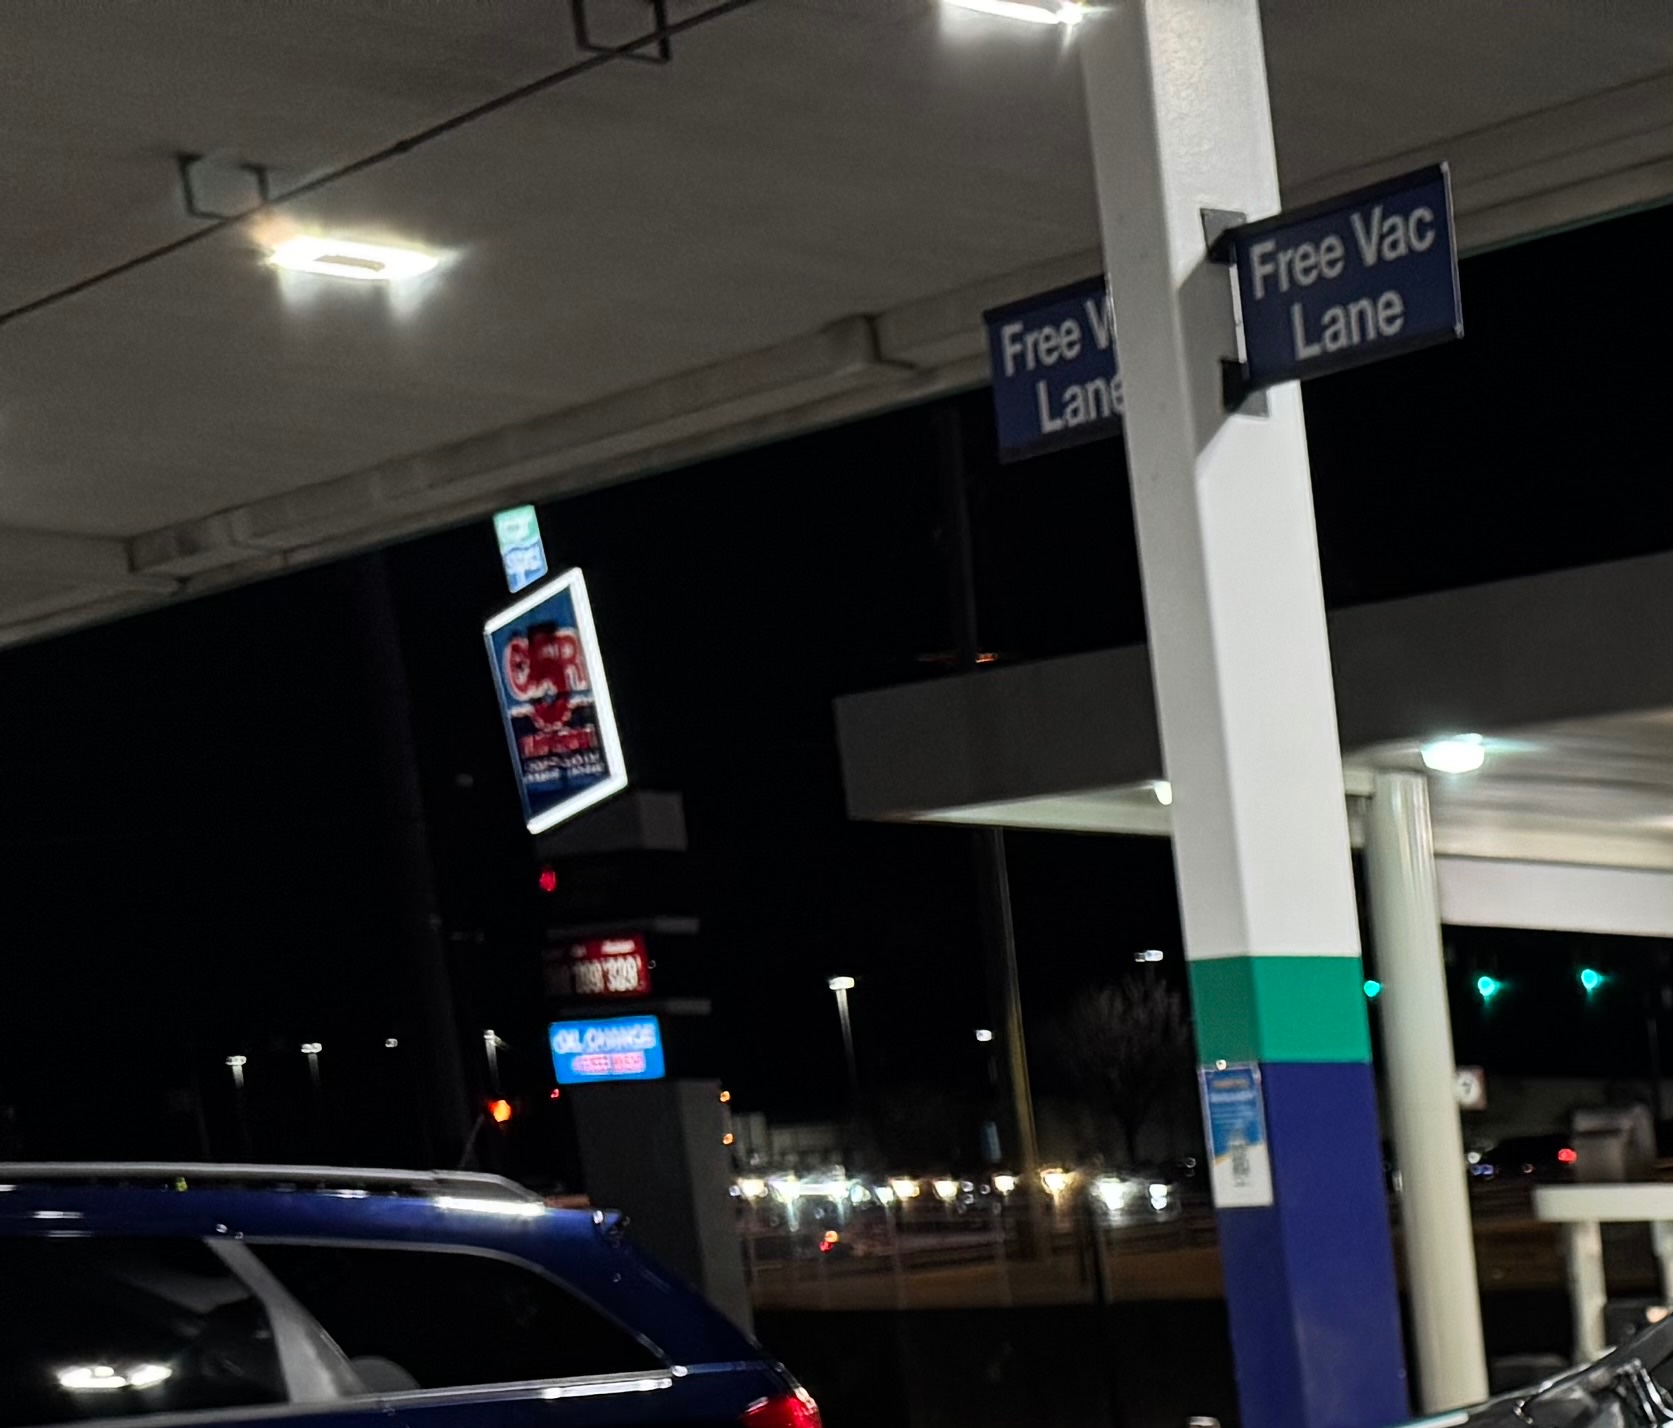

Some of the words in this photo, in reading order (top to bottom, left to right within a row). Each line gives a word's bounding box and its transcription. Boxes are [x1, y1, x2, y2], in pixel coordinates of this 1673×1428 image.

[1250, 234, 1345, 300] Free
[1350, 204, 1436, 267] Vac
[1001, 318, 1082, 378] Free
[1291, 290, 1405, 361] Lane
